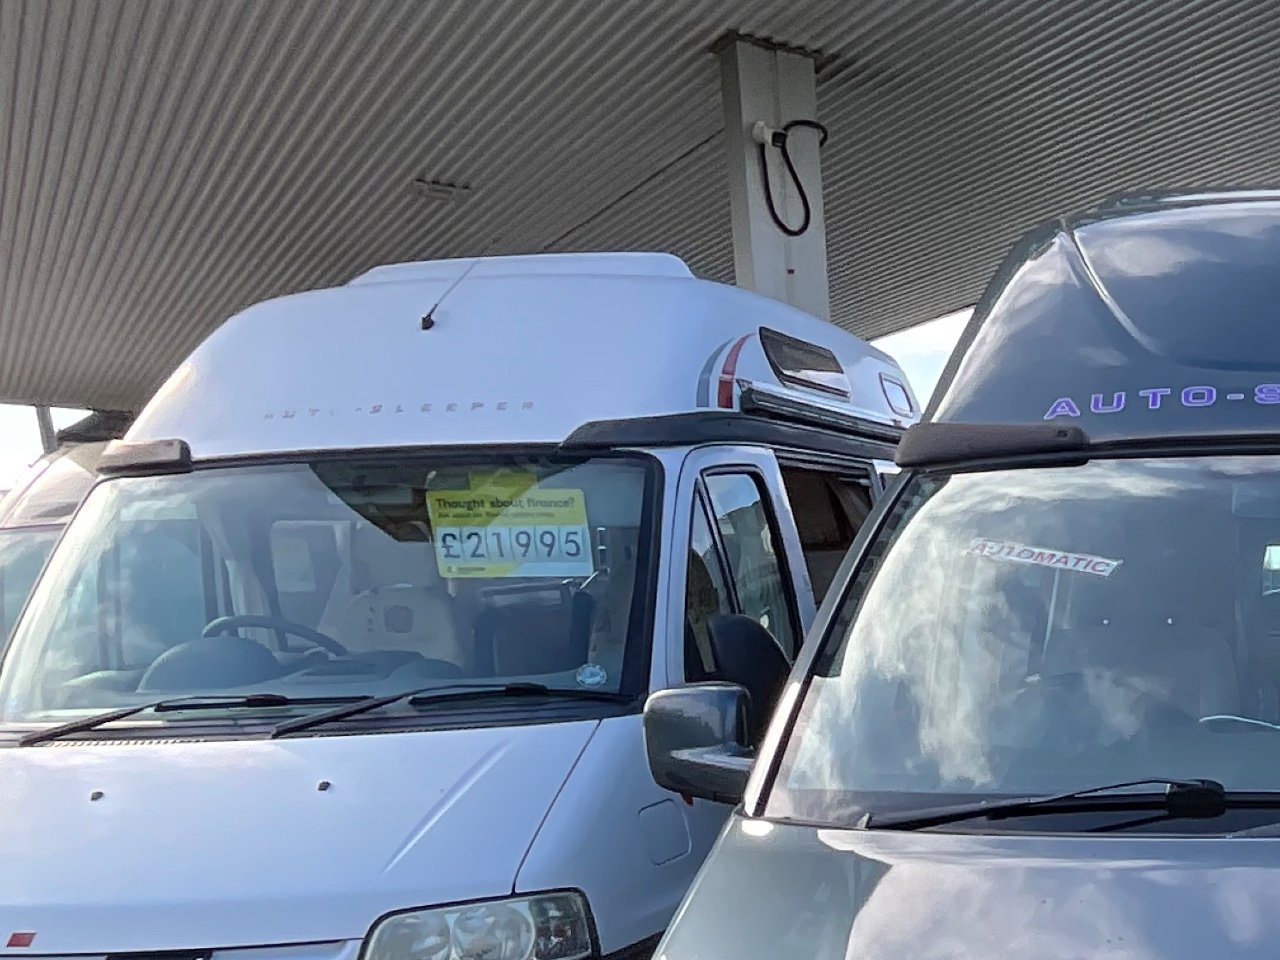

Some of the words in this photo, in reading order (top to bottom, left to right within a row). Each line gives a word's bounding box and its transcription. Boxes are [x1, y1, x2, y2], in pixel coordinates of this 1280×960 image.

[436, 497, 485, 511] Thought
[490, 496, 524, 509] about
[441, 530, 582, 559] £21995
[969, 542, 1112, 573] AUTOMATIC
